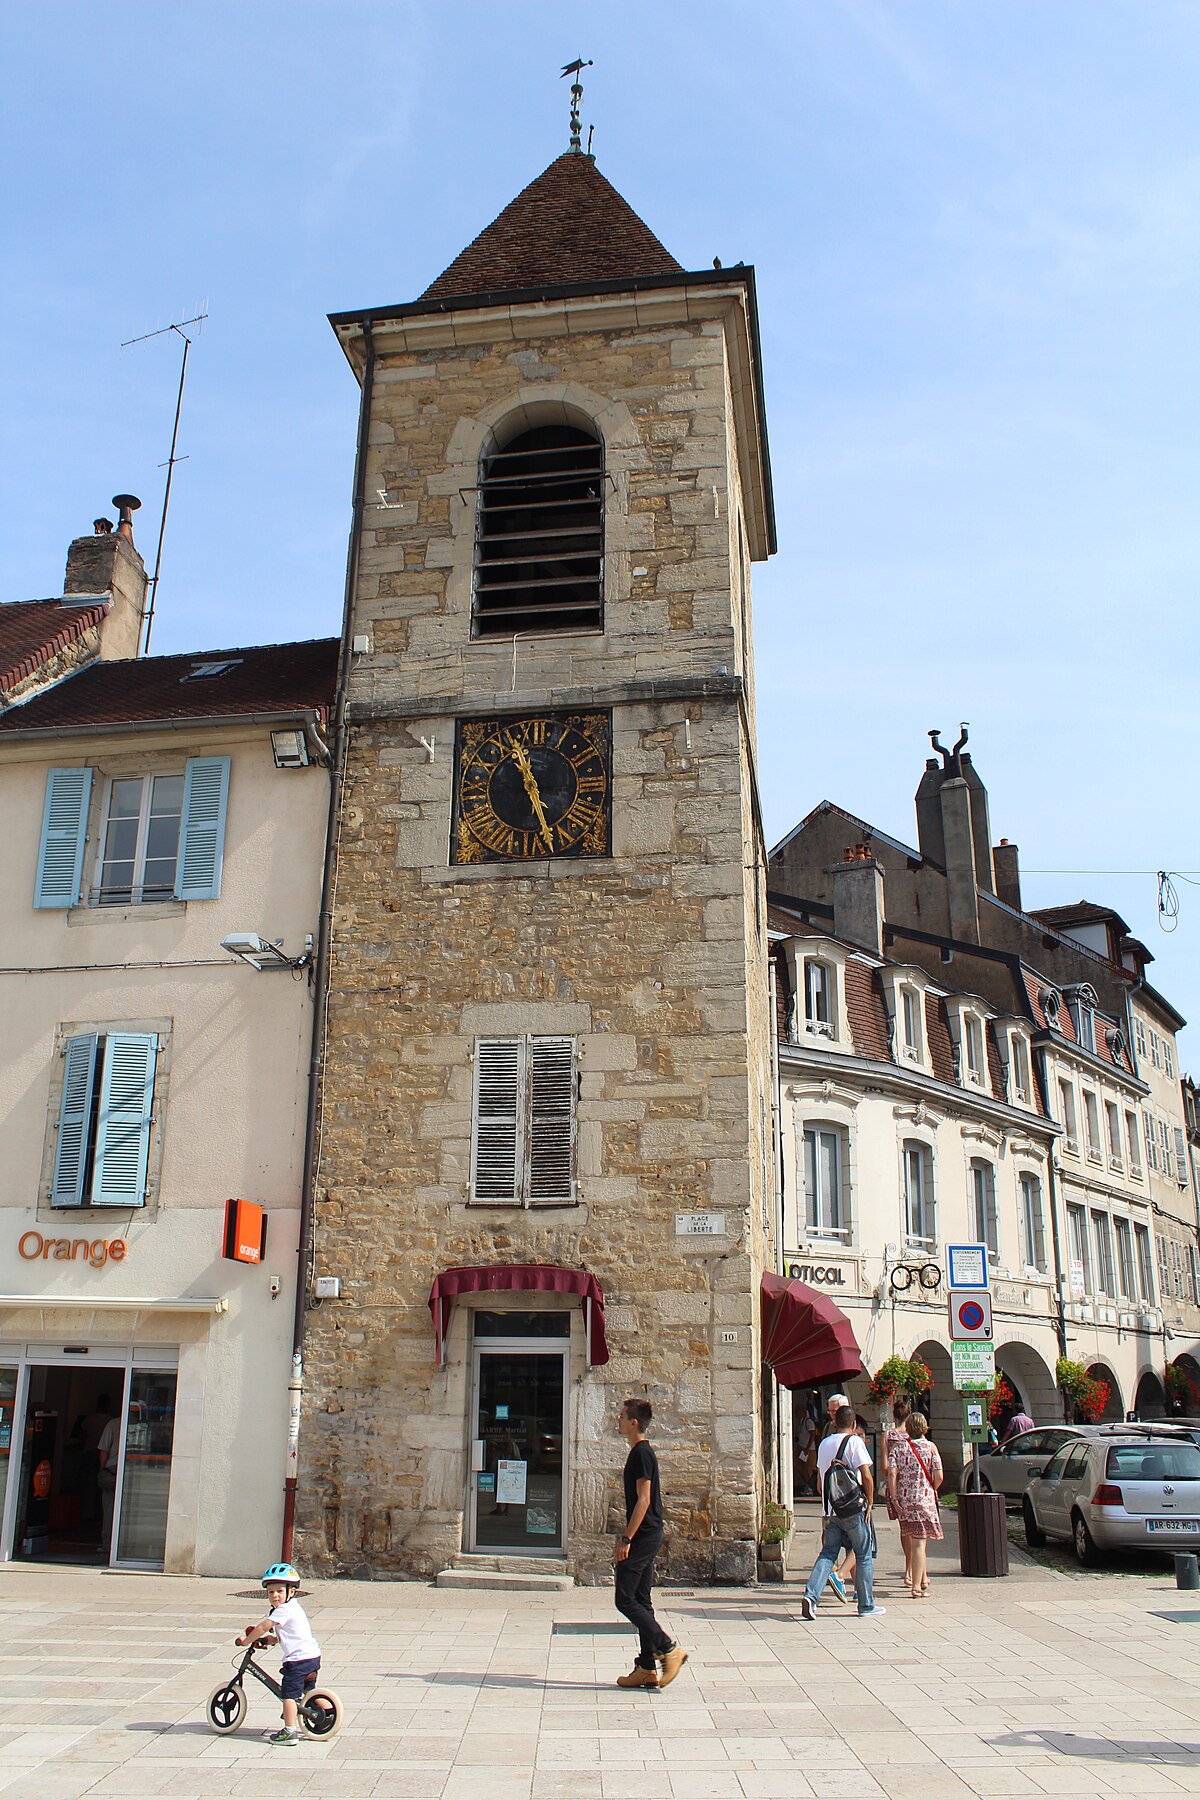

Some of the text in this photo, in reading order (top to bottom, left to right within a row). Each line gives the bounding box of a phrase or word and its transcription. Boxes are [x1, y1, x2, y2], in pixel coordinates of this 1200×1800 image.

[18, 1231, 126, 1268] Orange
[240, 1245, 259, 1260] orange
[953, 1342, 993, 1352] Lons le Saunier
